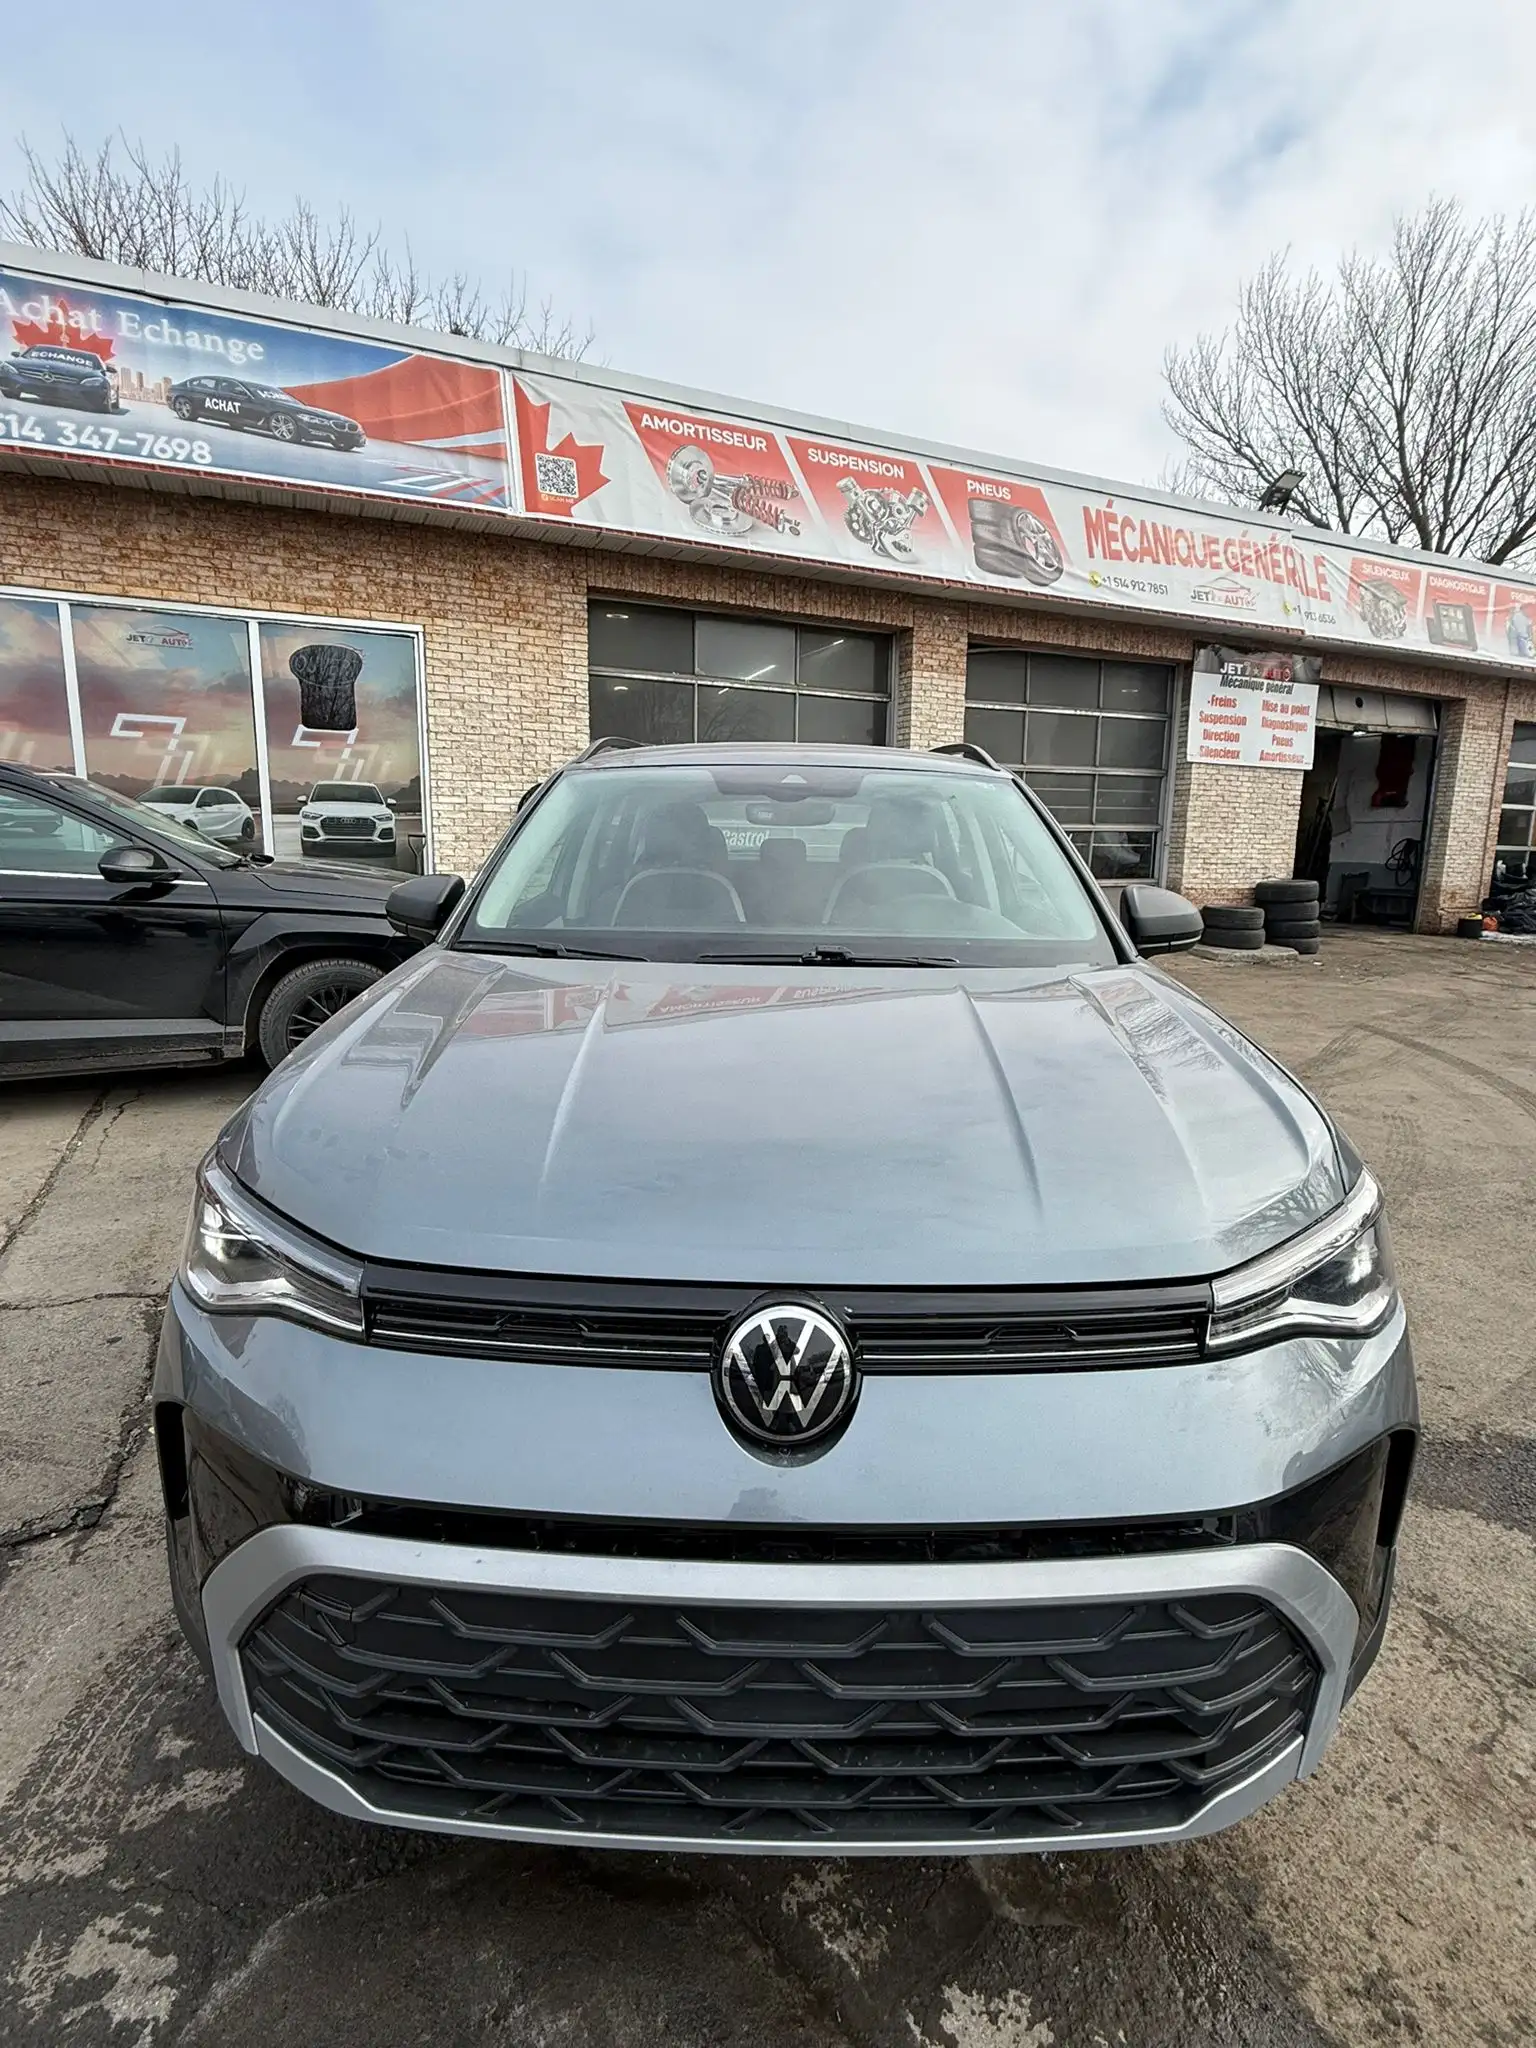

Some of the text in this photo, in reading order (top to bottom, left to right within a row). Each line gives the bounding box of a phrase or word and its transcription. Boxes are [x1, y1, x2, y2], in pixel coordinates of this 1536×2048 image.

[117, 310, 265, 364] Echange
[31, 351, 94, 367] ECHANGE
[205, 397, 242, 414] ACHAT
[640, 412, 768, 453] AMORTISSEUR
[57, 420, 213, 464] 347-7698
[807, 448, 905, 480] SUSPENSION
[966, 479, 1013, 501] PNEUS
[1082, 499, 1223, 571] MÉCANIQUE
[1114, 577, 1130, 590] 514
[1131, 581, 1146, 592] 912
[1147, 583, 1169, 596] 7851
[1429, 575, 1488, 596] DIAGNOSTIQUE
[1261, 699, 1310, 717] Mise au point
[1199, 711, 1247, 726] Suspension
[1261, 716, 1309, 733] Diagnostique
[1203, 728, 1241, 743] Direction
[1271, 733, 1294, 748] Pneus
[1199, 745, 1241, 760] Silencieux
